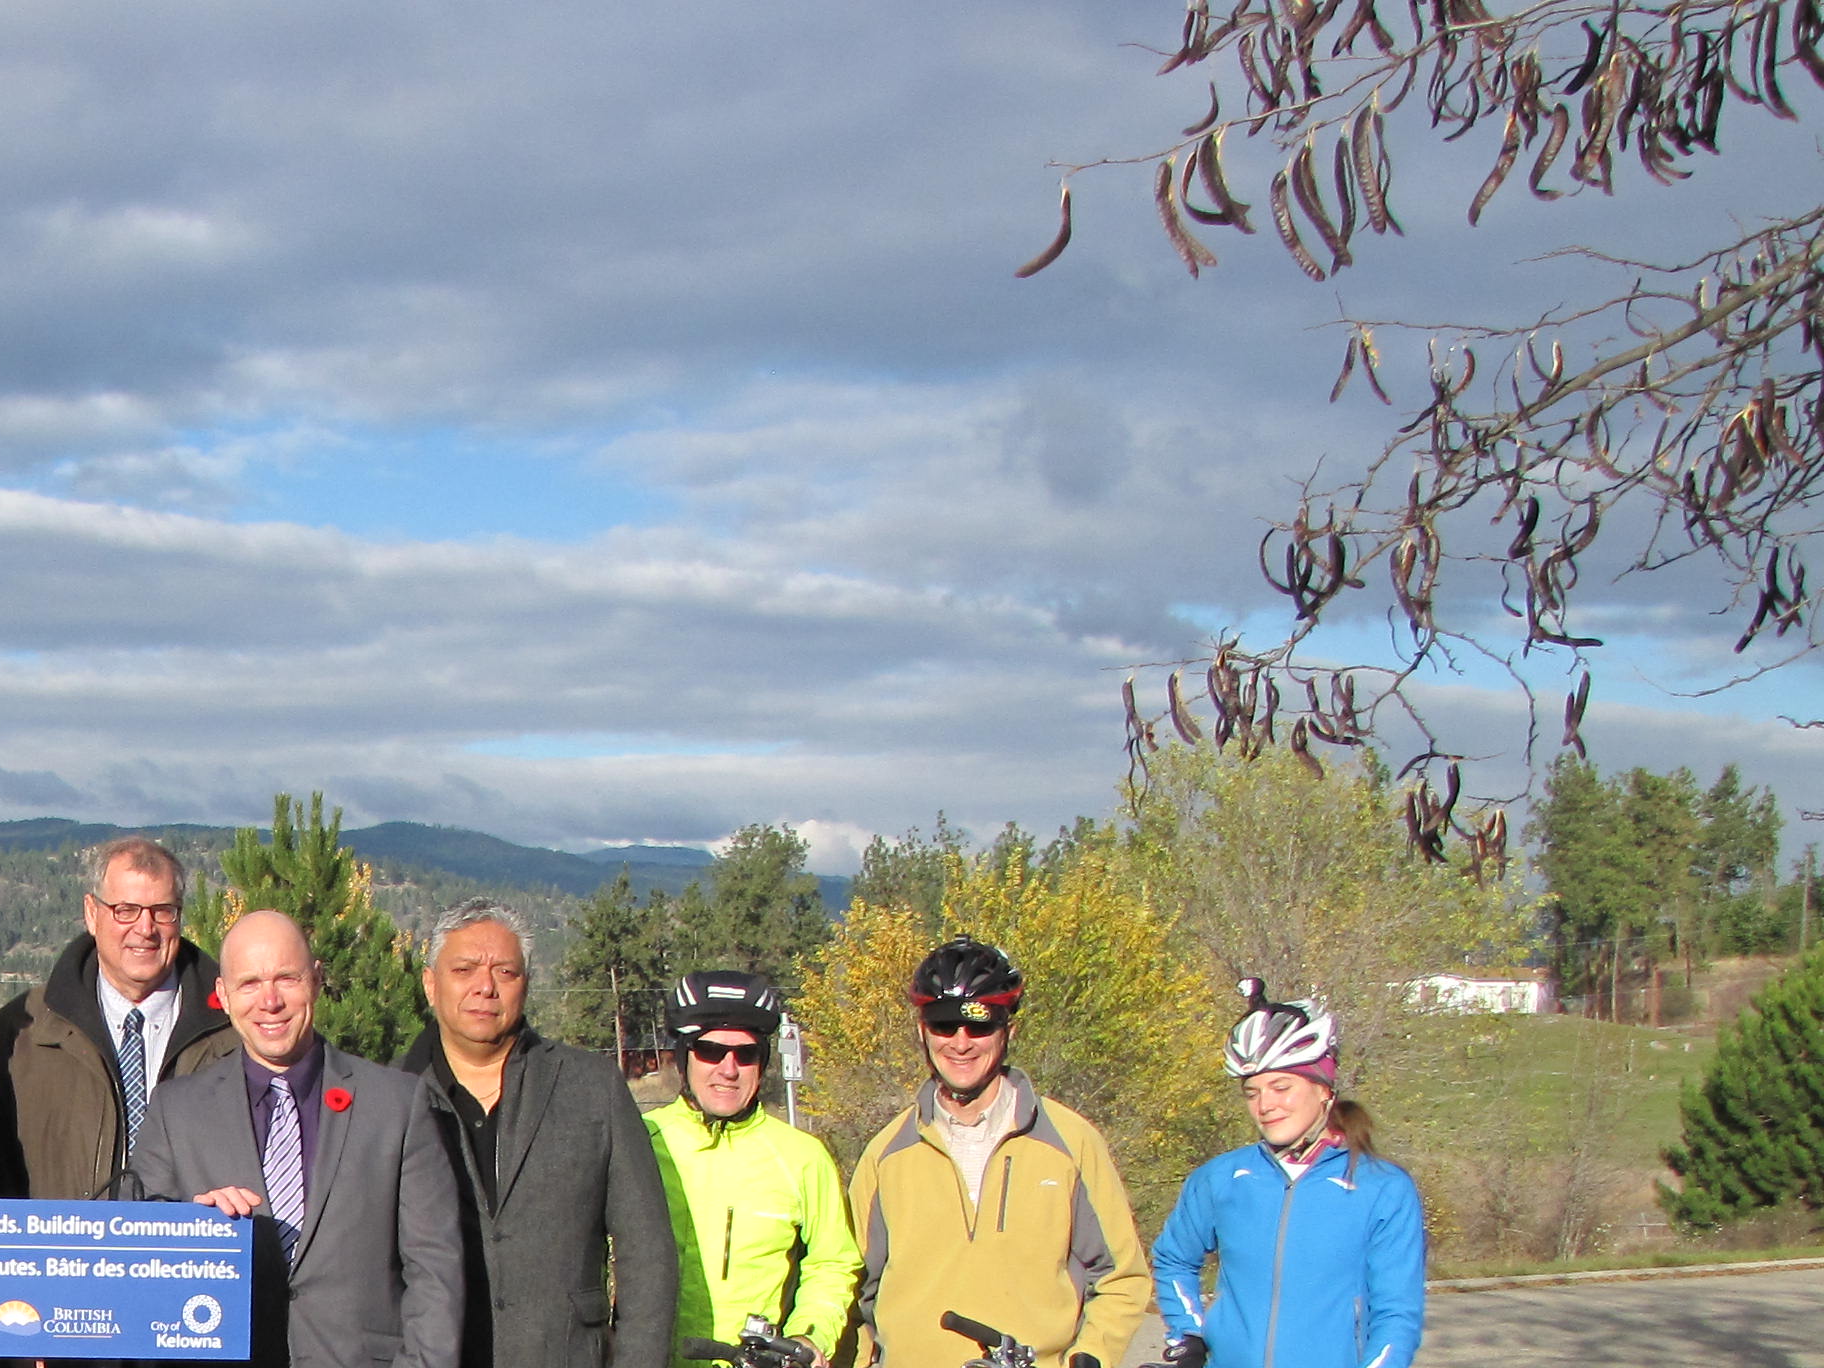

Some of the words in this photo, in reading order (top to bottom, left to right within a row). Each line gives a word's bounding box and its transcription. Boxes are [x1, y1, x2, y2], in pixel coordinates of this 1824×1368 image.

[26, 1214, 105, 1241] Building
[109, 1216, 238, 1239] Communities.
[45, 1257, 90, 1278] Bâtir
[92, 1257, 126, 1278] des
[129, 1258, 241, 1281] collectivités.
[53, 1307, 113, 1322] BRITISH
[43, 1320, 122, 1335] COLUMBIA
[150, 1320, 169, 1333] City
[170, 1320, 181, 1331] of
[156, 1333, 222, 1349] Kelowna
